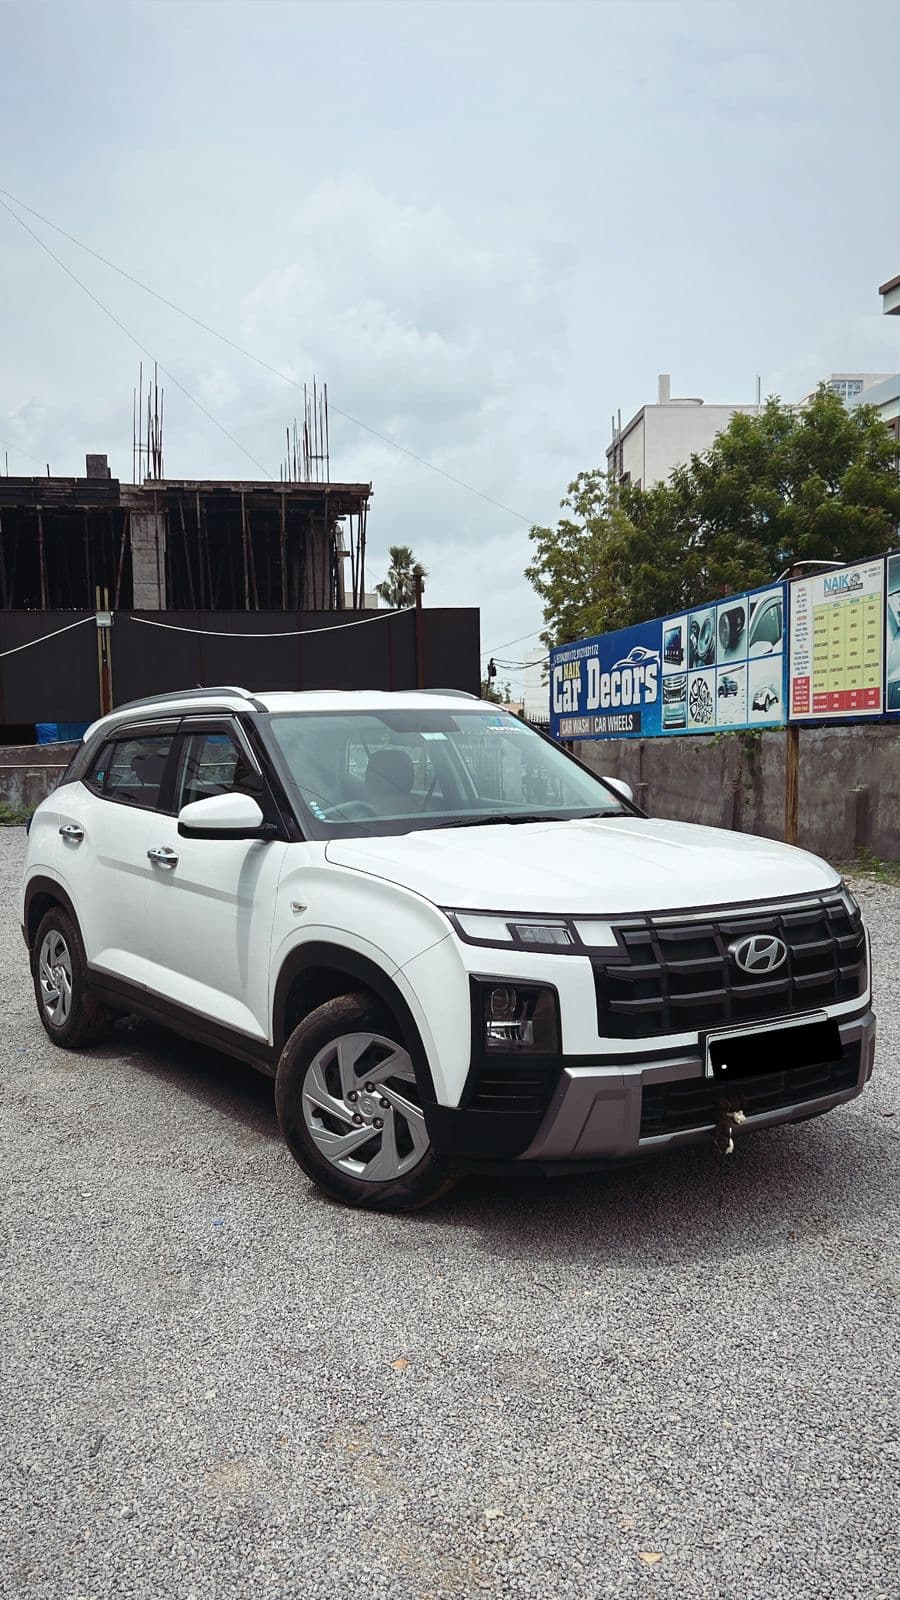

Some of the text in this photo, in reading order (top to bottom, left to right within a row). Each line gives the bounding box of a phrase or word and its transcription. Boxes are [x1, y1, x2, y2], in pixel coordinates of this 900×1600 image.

[823, 573, 849, 592] NAIK
[563, 660, 581, 680] NAIK
[553, 657, 658, 714] Car Decors
[562, 719, 590, 735] CAR WASH
[594, 714, 633, 732] CAR WHEELS
